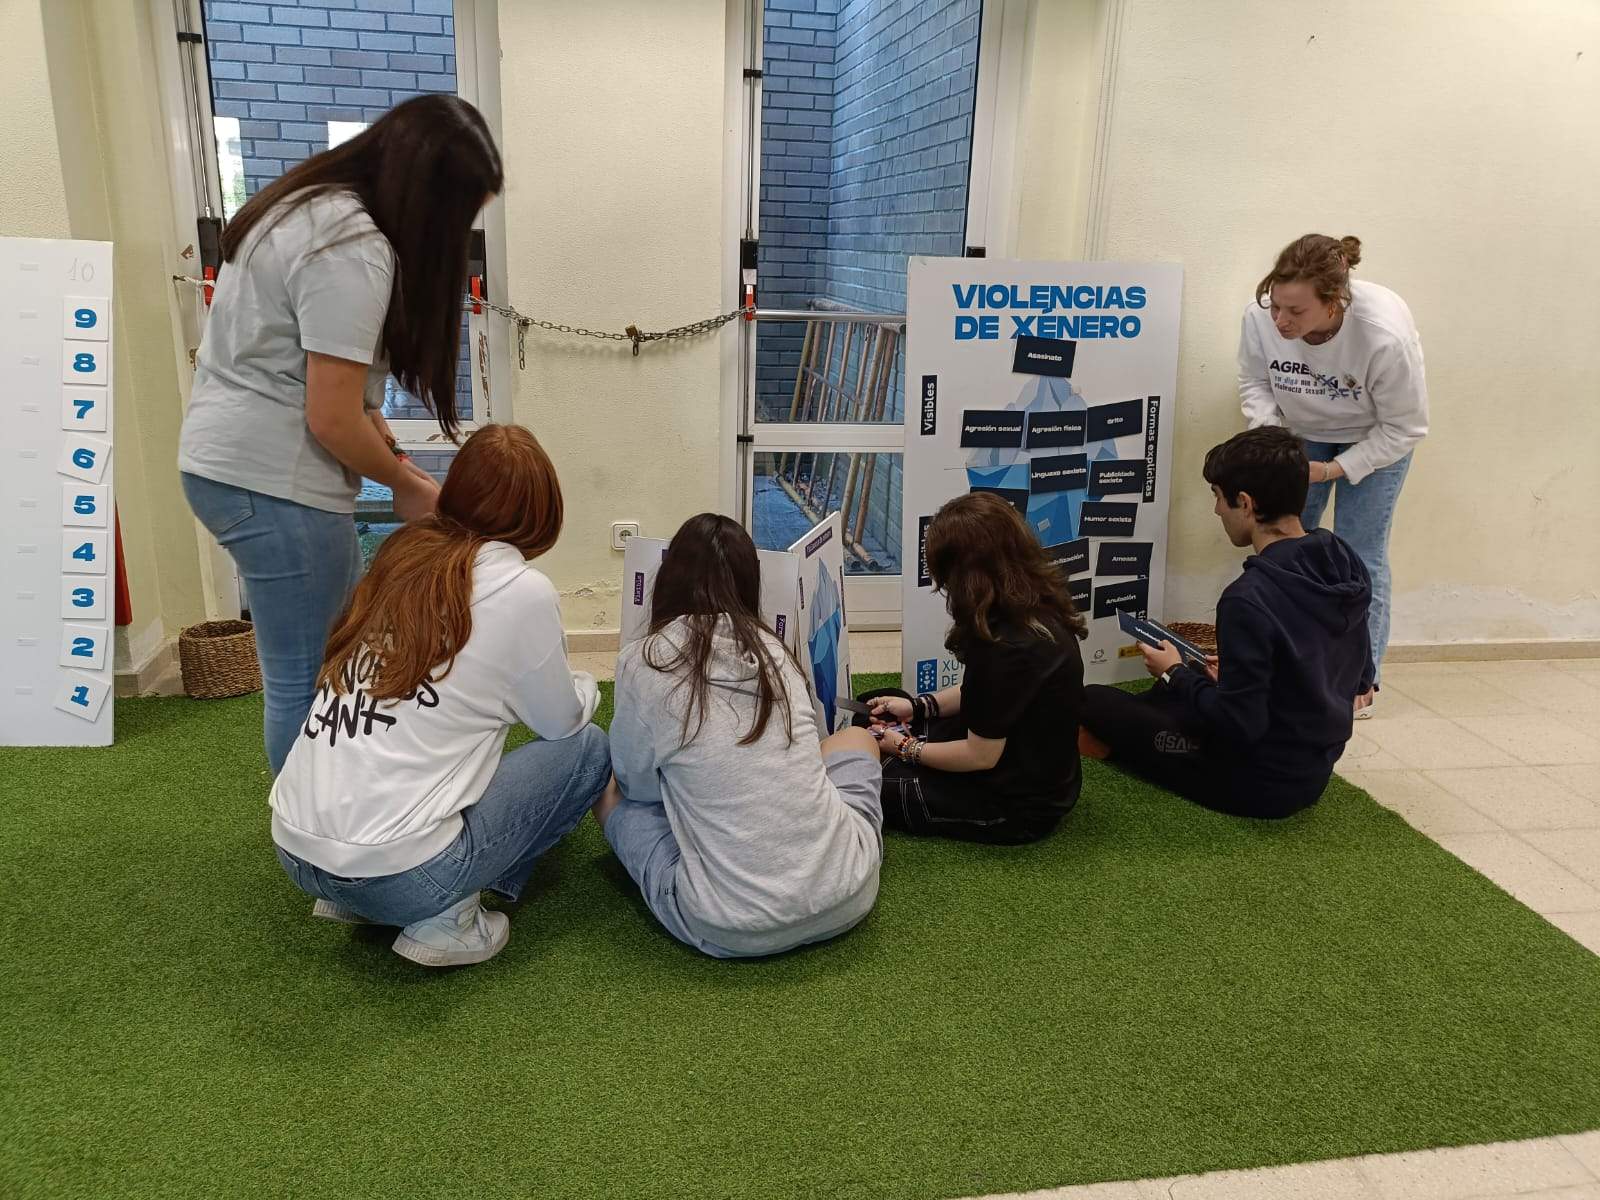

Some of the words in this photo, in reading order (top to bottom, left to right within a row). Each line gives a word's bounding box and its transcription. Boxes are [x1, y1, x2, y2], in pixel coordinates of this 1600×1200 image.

[952, 284, 1146, 309] VIOLENCIAS
[74, 308, 97, 329] 9
[954, 315, 1000, 340] DE
[1010, 307, 1141, 340] XÉNERO
[73, 352, 97, 373] 8
[73, 399, 95, 419] 7
[924, 382, 935, 432] Visibles
[964, 424, 997, 434] Agresión
[998, 425, 1022, 433] sexual
[1031, 425, 1062, 435] Agresión
[1149, 400, 1159, 441] Formas
[72, 448, 96, 470] 6
[73, 495, 96, 515] 5
[1084, 515, 1107, 523] Humor
[72, 542, 96, 562] 4
[72, 587, 95, 608] 3
[71, 637, 95, 658] 2
[70, 686, 90, 707] 1
